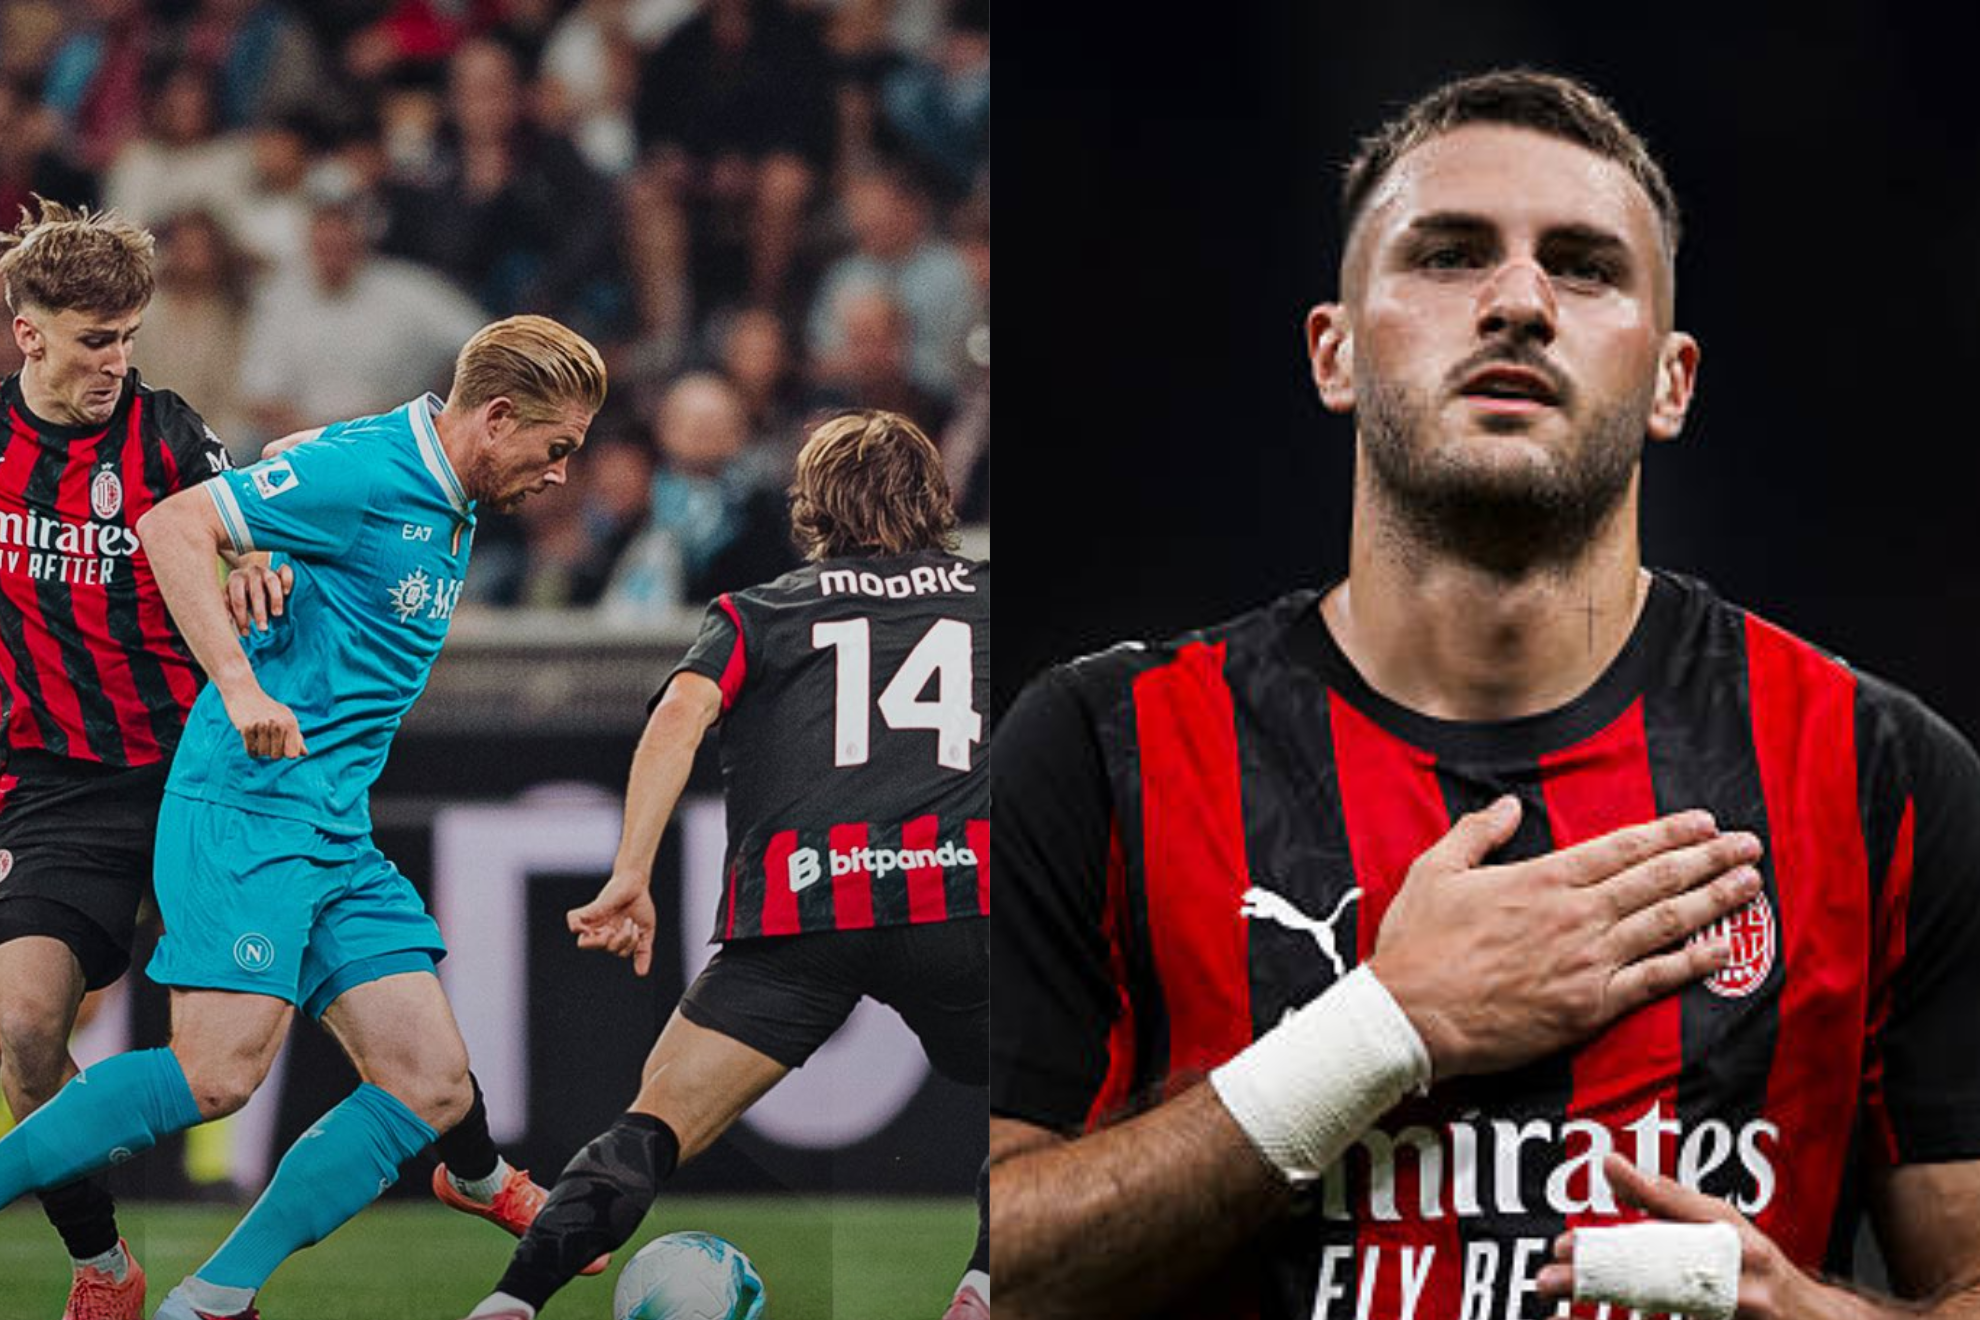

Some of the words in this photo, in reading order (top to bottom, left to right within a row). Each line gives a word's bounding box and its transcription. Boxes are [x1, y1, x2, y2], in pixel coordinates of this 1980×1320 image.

[402, 523, 433, 542] EA7
[819, 562, 976, 598] MODRIĆ
[811, 617, 982, 772] 14
[829, 841, 978, 879] bitpanda
[245, 942, 263, 963] N
[1300, 1099, 1781, 1219] mirates
